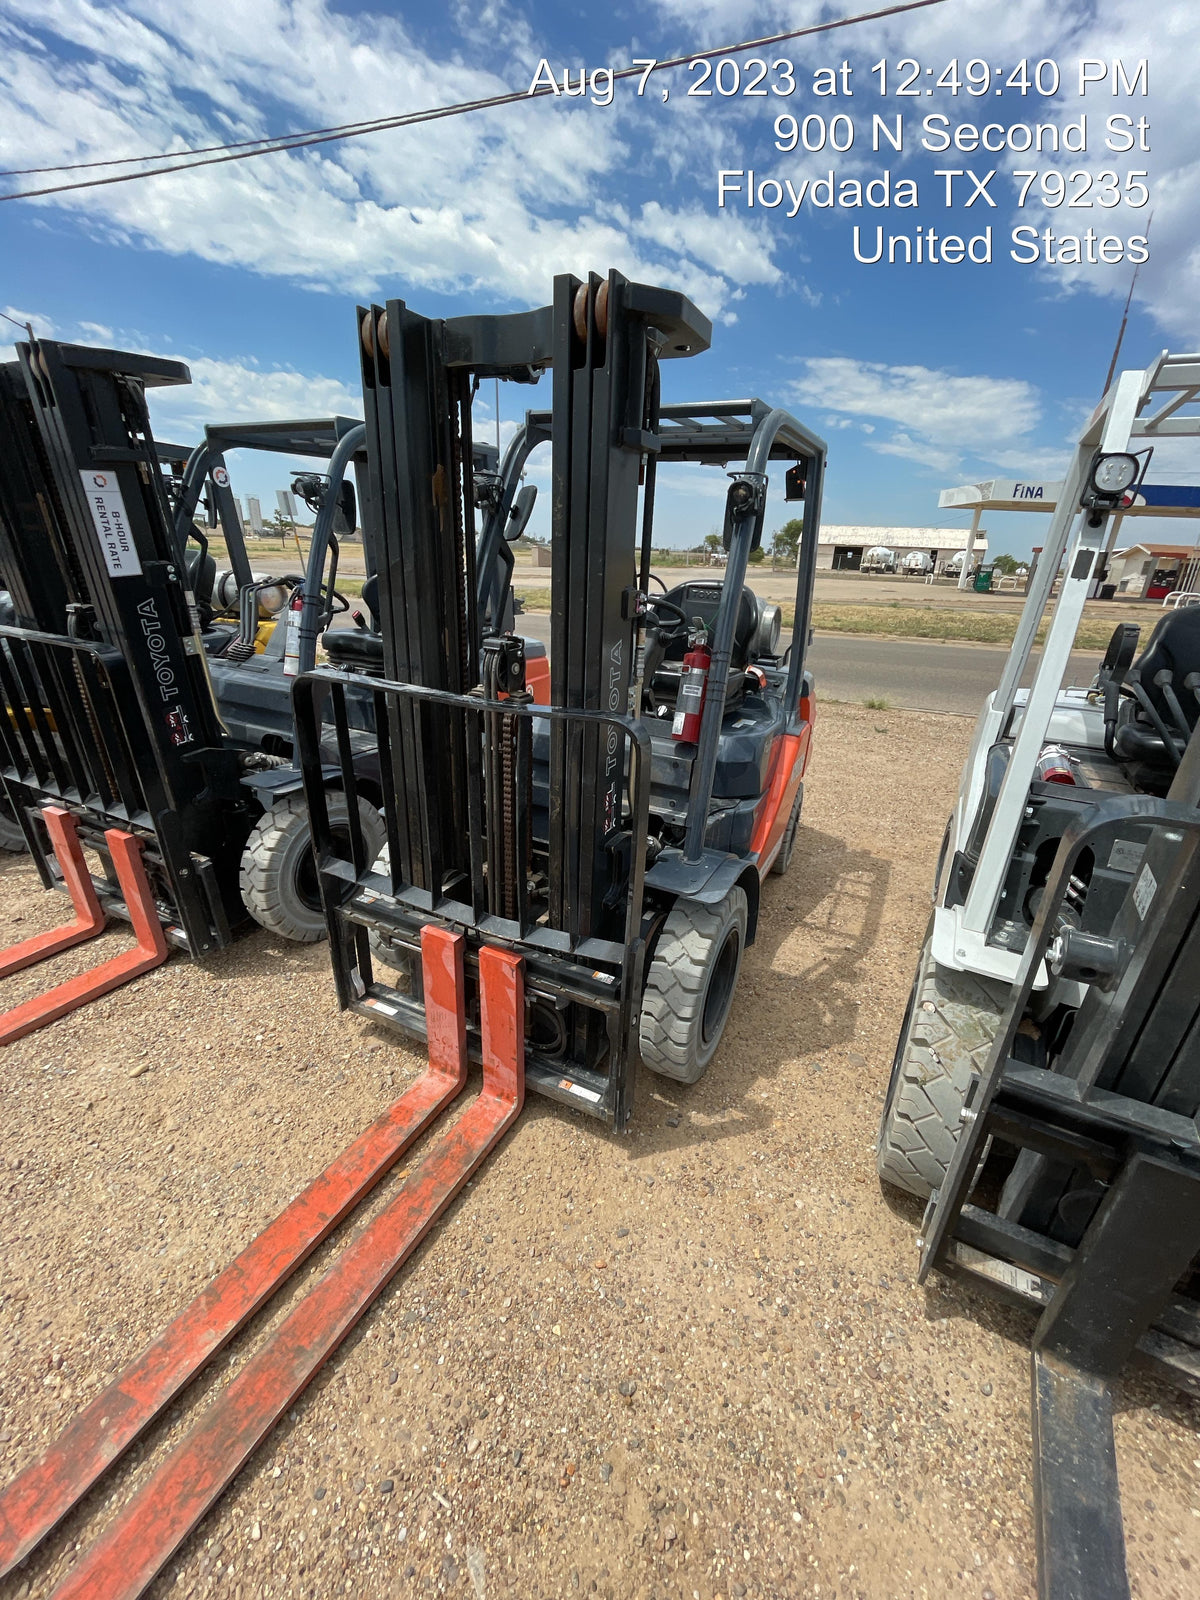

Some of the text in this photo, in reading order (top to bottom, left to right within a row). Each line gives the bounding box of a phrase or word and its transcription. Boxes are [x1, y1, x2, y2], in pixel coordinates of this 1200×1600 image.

[94, 496, 122, 570] RENTAL RATE
[137, 597, 179, 701] TOYOTA
[606, 639, 623, 776] TOOTA
